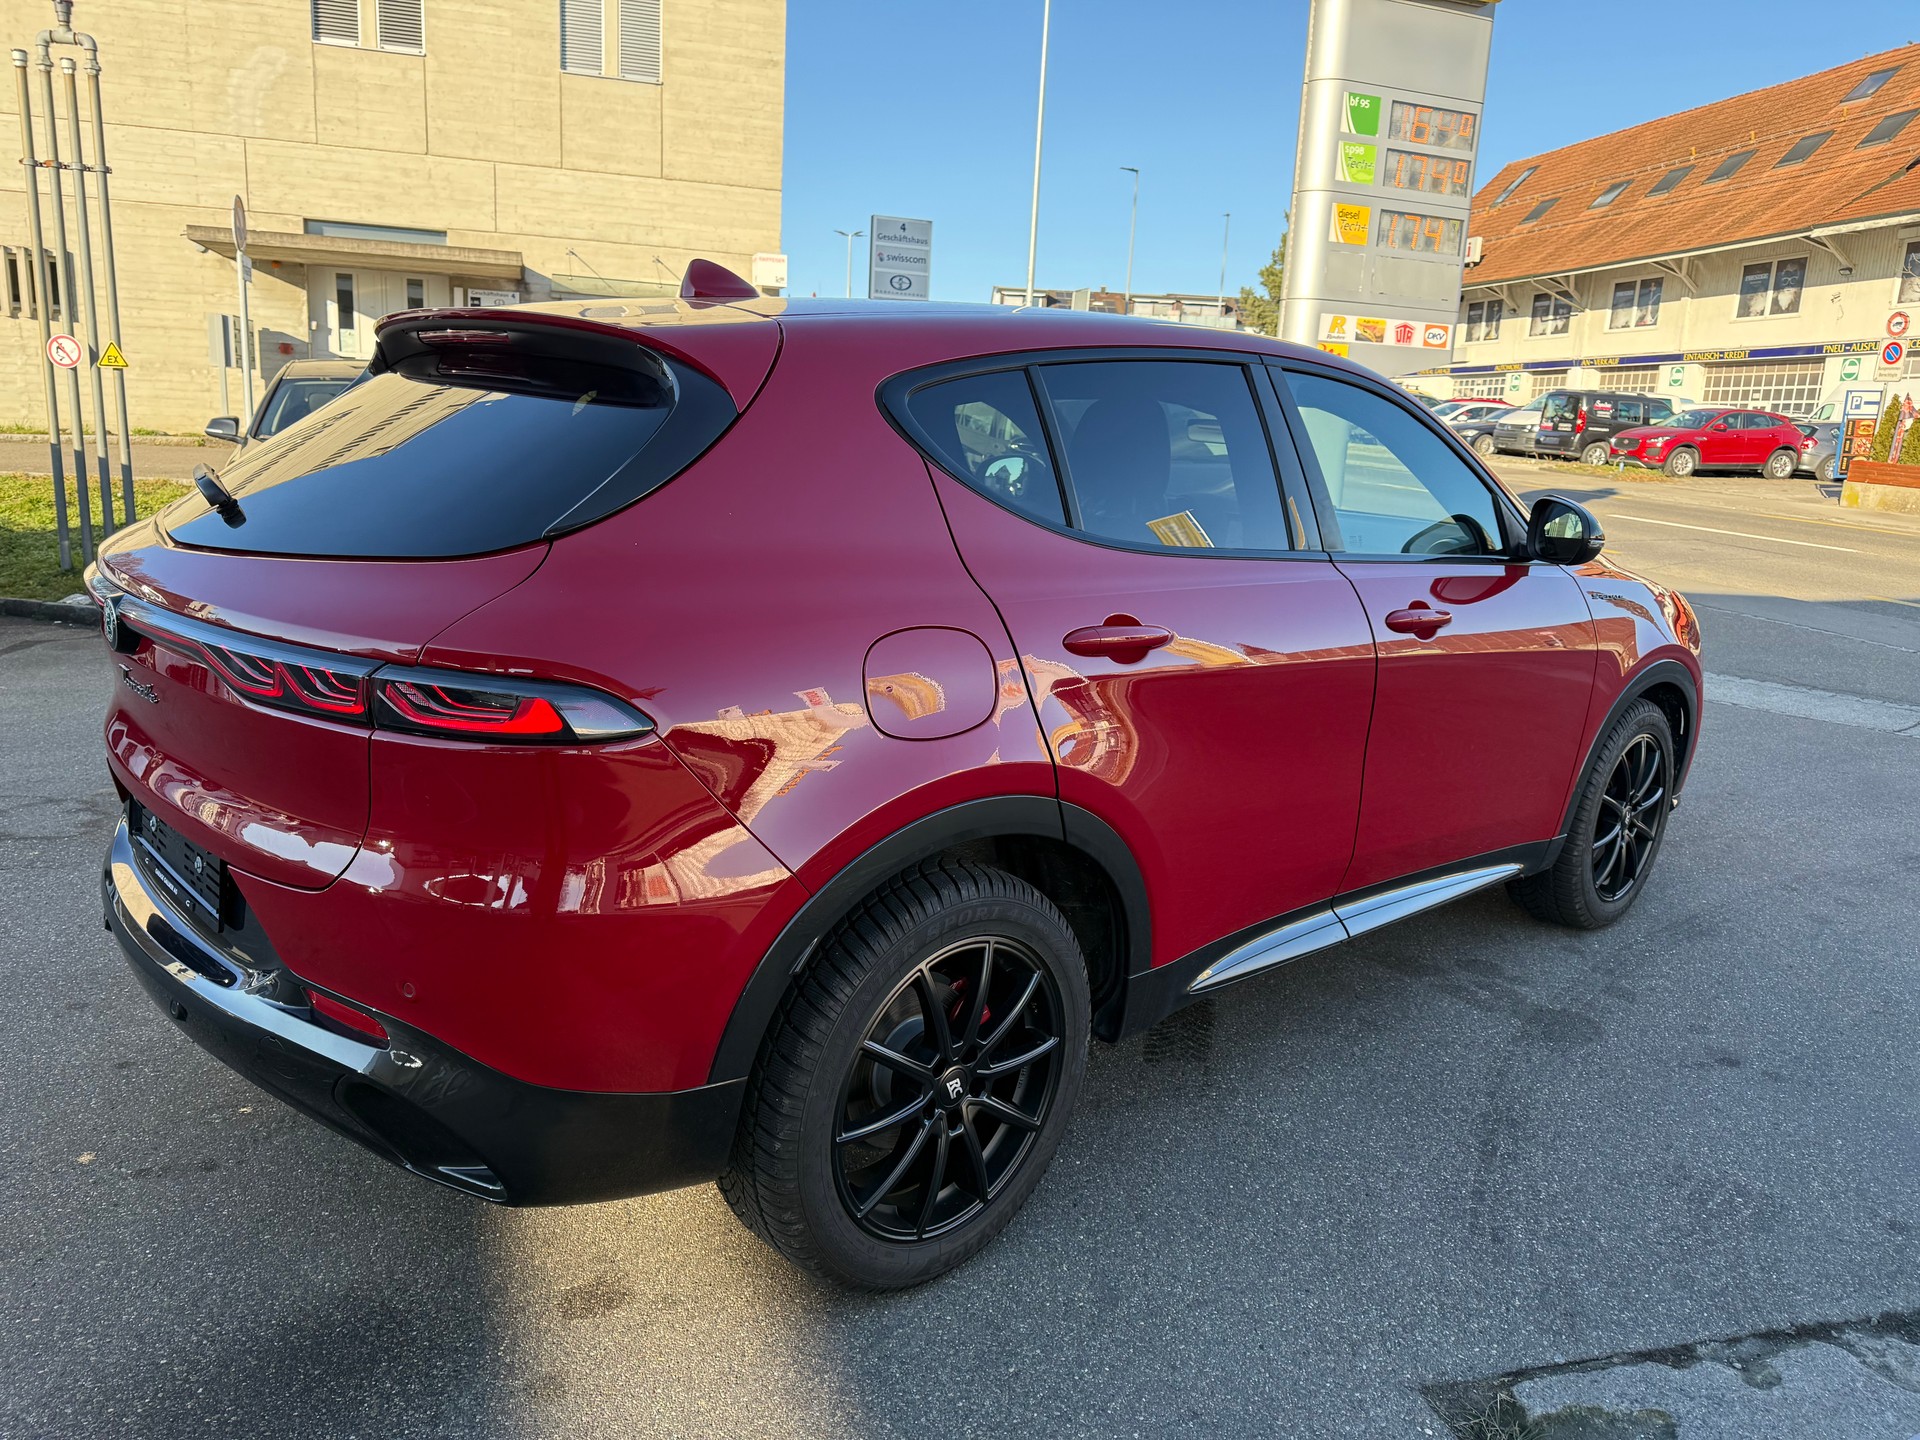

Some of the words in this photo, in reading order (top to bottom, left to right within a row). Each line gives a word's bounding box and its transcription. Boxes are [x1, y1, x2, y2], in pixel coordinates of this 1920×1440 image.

[1350, 96, 1359, 107] bf
[1360, 99, 1371, 109] 95
[1338, 209, 1361, 220] diesel
[900, 223, 906, 233] 4
[877, 232, 929, 245] Geschäftshaus
[886, 253, 927, 265] swisscom
[1328, 315, 1346, 334] R
[1427, 331, 1445, 341] DKV
[107, 354, 119, 364] EX
[926, 905, 1001, 939] SPORT
